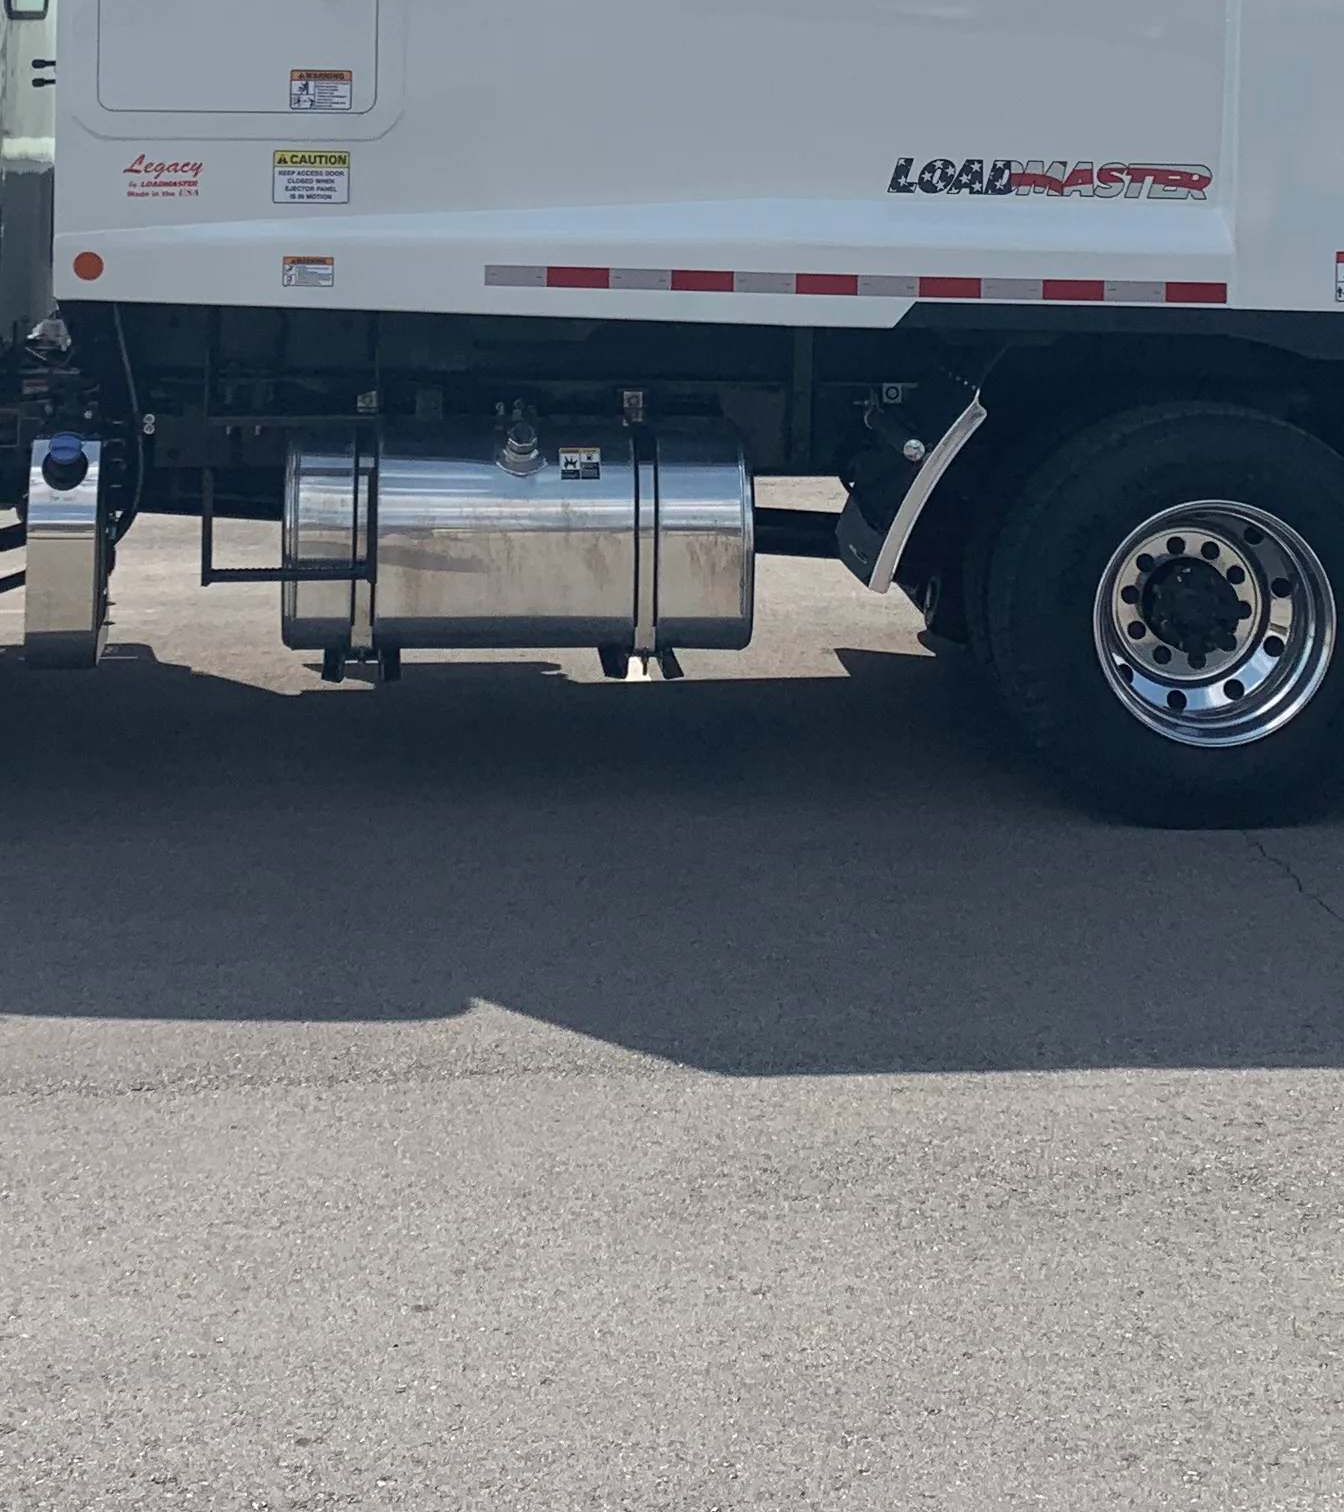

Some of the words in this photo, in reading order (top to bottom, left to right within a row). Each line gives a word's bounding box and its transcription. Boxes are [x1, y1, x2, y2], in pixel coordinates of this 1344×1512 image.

[122, 153, 203, 180] Legacy
[289, 154, 347, 165] CAUTION
[887, 157, 1212, 200] LOADMASTER
